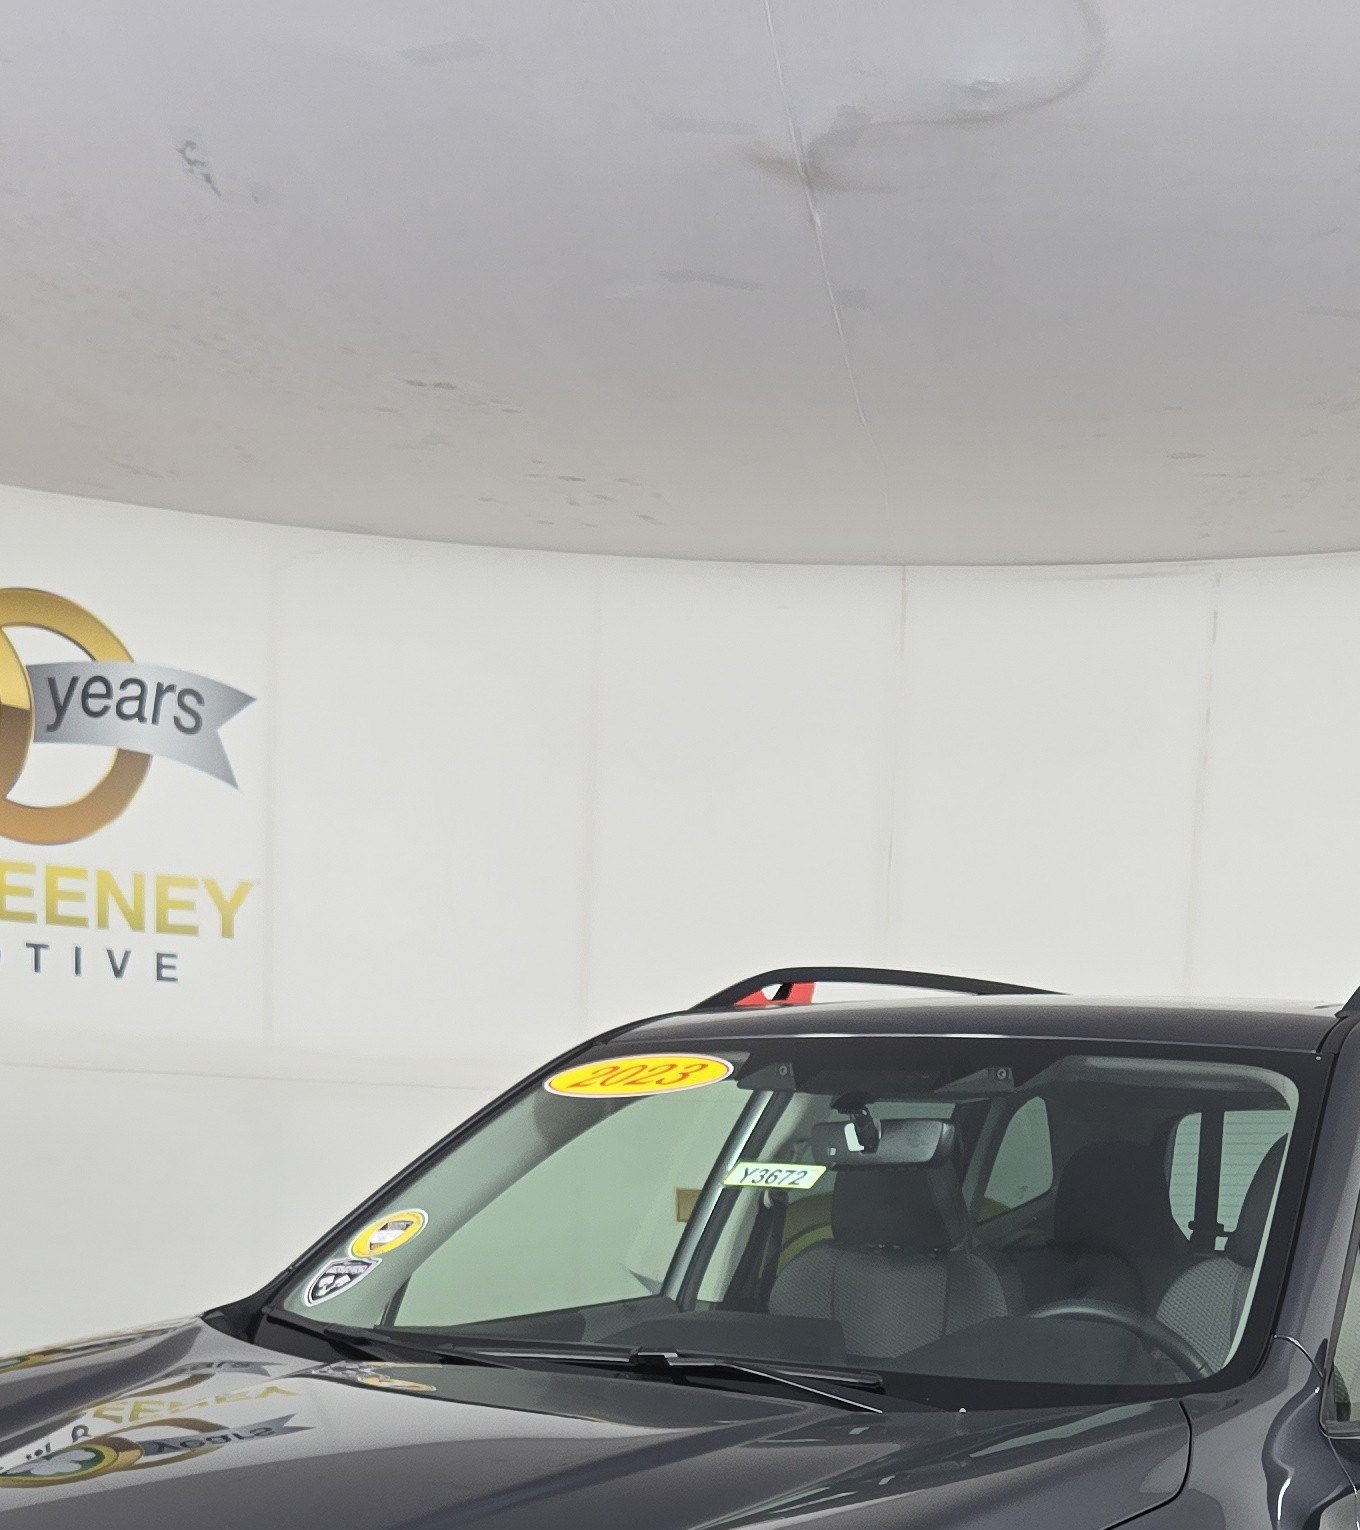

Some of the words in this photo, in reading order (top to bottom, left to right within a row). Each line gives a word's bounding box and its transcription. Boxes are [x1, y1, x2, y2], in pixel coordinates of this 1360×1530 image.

[44, 674, 206, 735] years
[566, 1062, 709, 1089] 2023
[739, 1167, 809, 1186] Y3672
